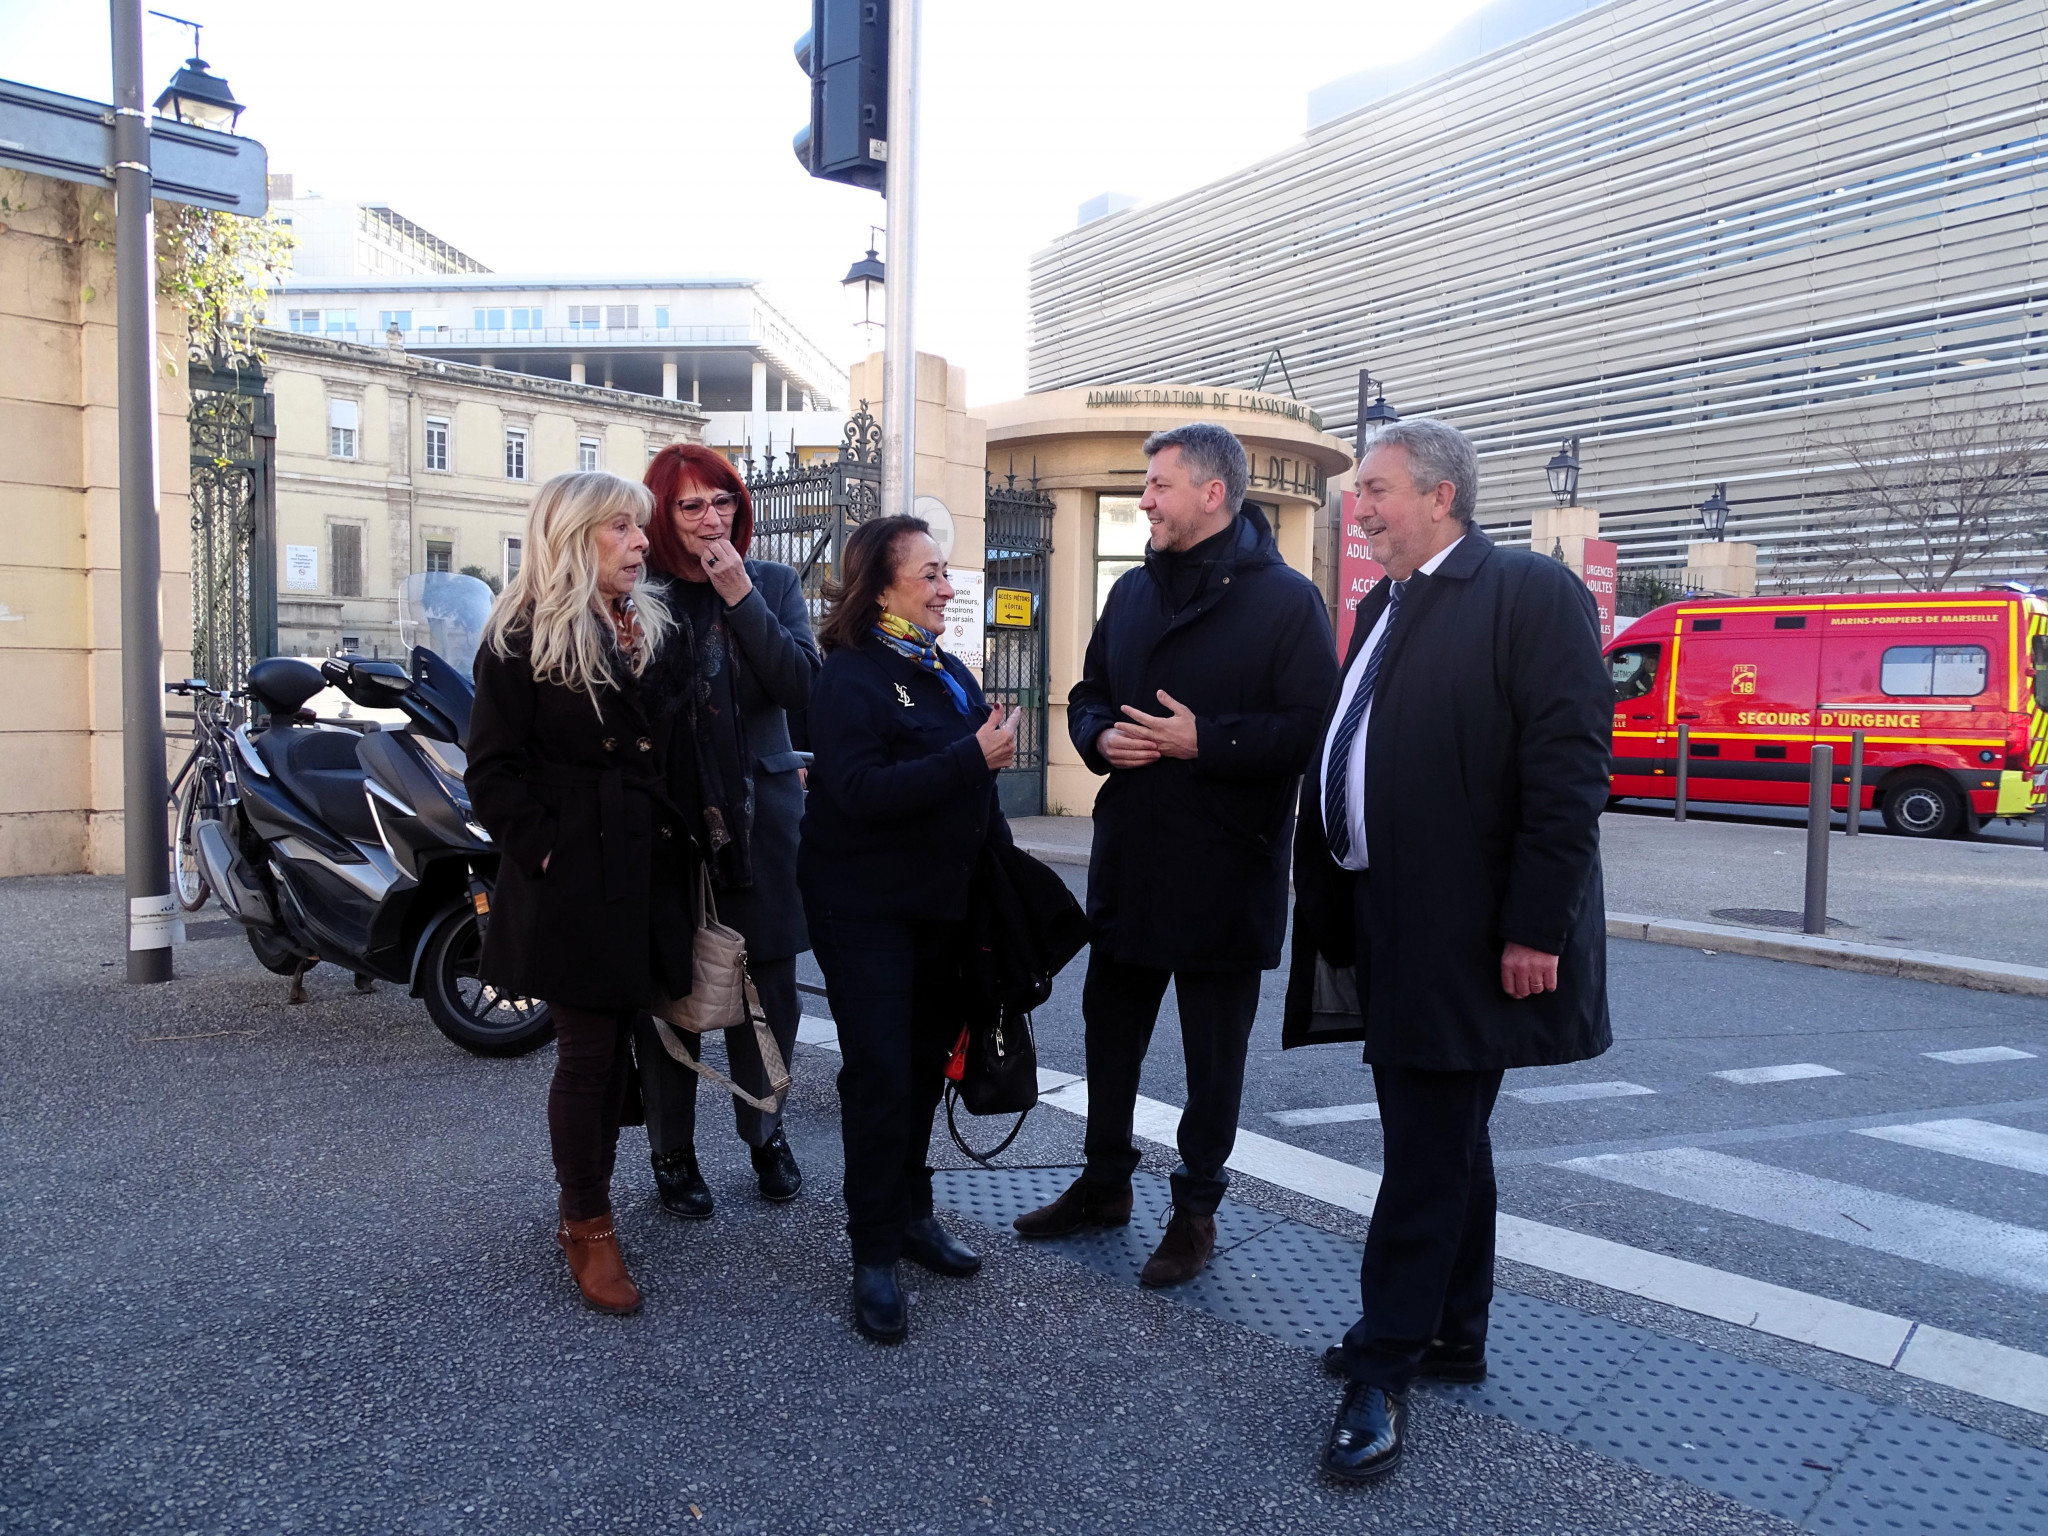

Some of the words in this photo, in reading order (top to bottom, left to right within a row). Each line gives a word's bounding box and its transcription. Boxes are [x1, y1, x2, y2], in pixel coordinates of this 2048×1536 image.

[1086, 389, 1204, 410] ADMINISTRATION
[1213, 392, 1230, 411] DE
[1269, 455, 1291, 491] DE
[1346, 542, 1372, 560] ADUL
[1586, 564, 1614, 578] URGENCES
[952, 614, 961, 622] air
[1831, 615, 1924, 626] MARINS-POMPIERS
[1925, 615, 1939, 623] DE
[1941, 614, 1999, 623] MARSEILLE
[1735, 665, 1748, 673] 112
[1739, 682, 1753, 693] 18
[1737, 712, 1811, 726] SECOURS
[1821, 711, 1921, 728] D'URGENCE
